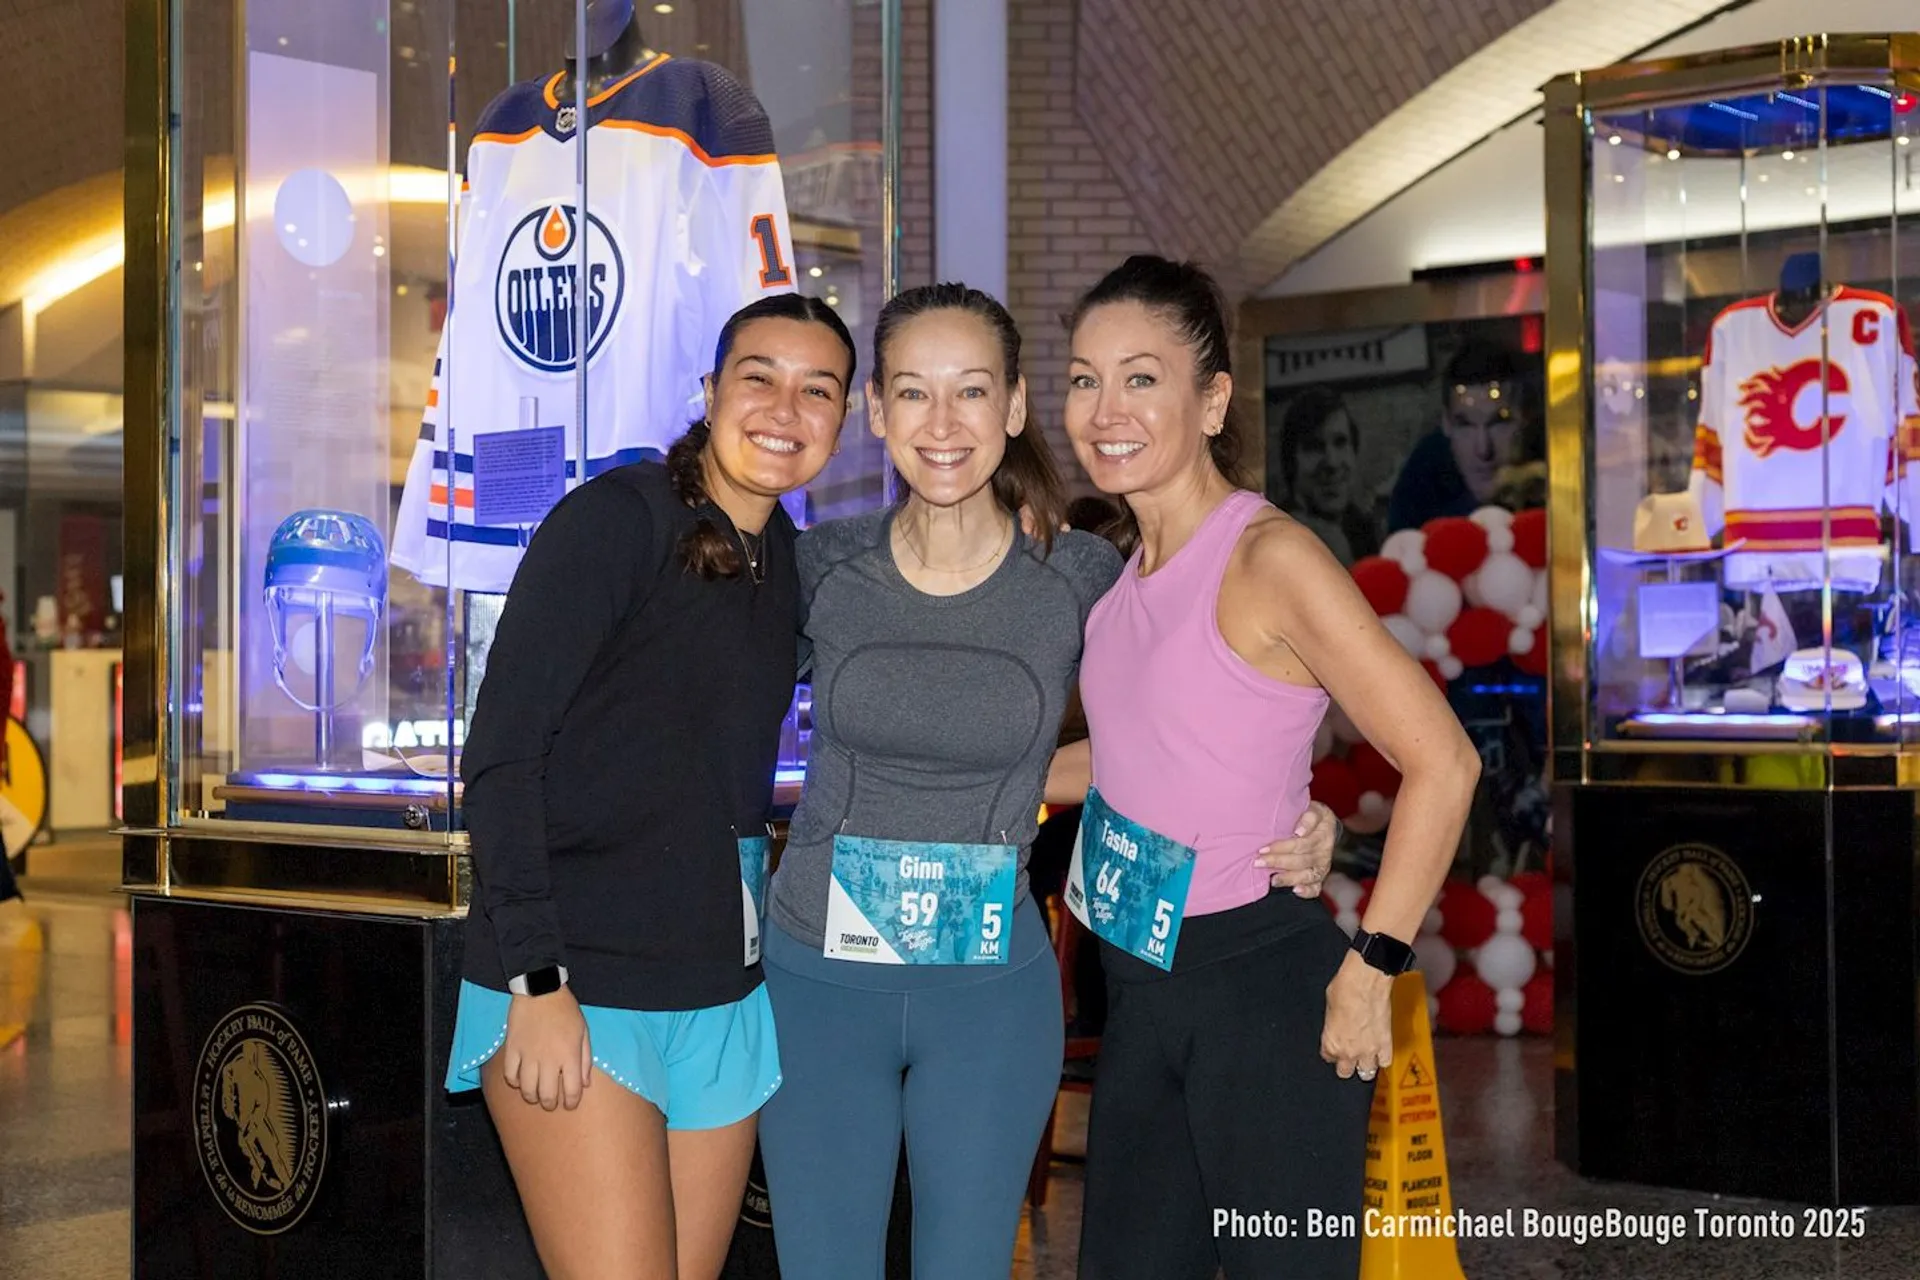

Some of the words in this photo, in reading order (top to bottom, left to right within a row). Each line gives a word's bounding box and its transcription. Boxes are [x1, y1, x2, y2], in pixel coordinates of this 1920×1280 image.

[751, 213, 792, 288] 1
[1852, 308, 1880, 346] C
[1101, 819, 1138, 862] Tasha
[899, 855, 943, 879] Ginn
[1096, 862, 1123, 903] 64
[900, 891, 939, 926] 59
[982, 903, 1002, 940] 5
[1152, 899, 1174, 940] 5
[840, 933, 879, 947] TORONTO
[980, 940, 999, 955] KM
[1147, 937, 1166, 956] KM
[206, 1016, 244, 1069] HOCKEY
[246, 1015, 276, 1036] HALL
[276, 1030, 292, 1046] of
[287, 1040, 312, 1085] FAME
[234, 1194, 296, 1220] RENOMMÉE
[303, 1100, 319, 1180] HOCKEY
[1408, 1149, 1433, 1162] FLOOR
[1402, 1176, 1442, 1193] PLANCHER
